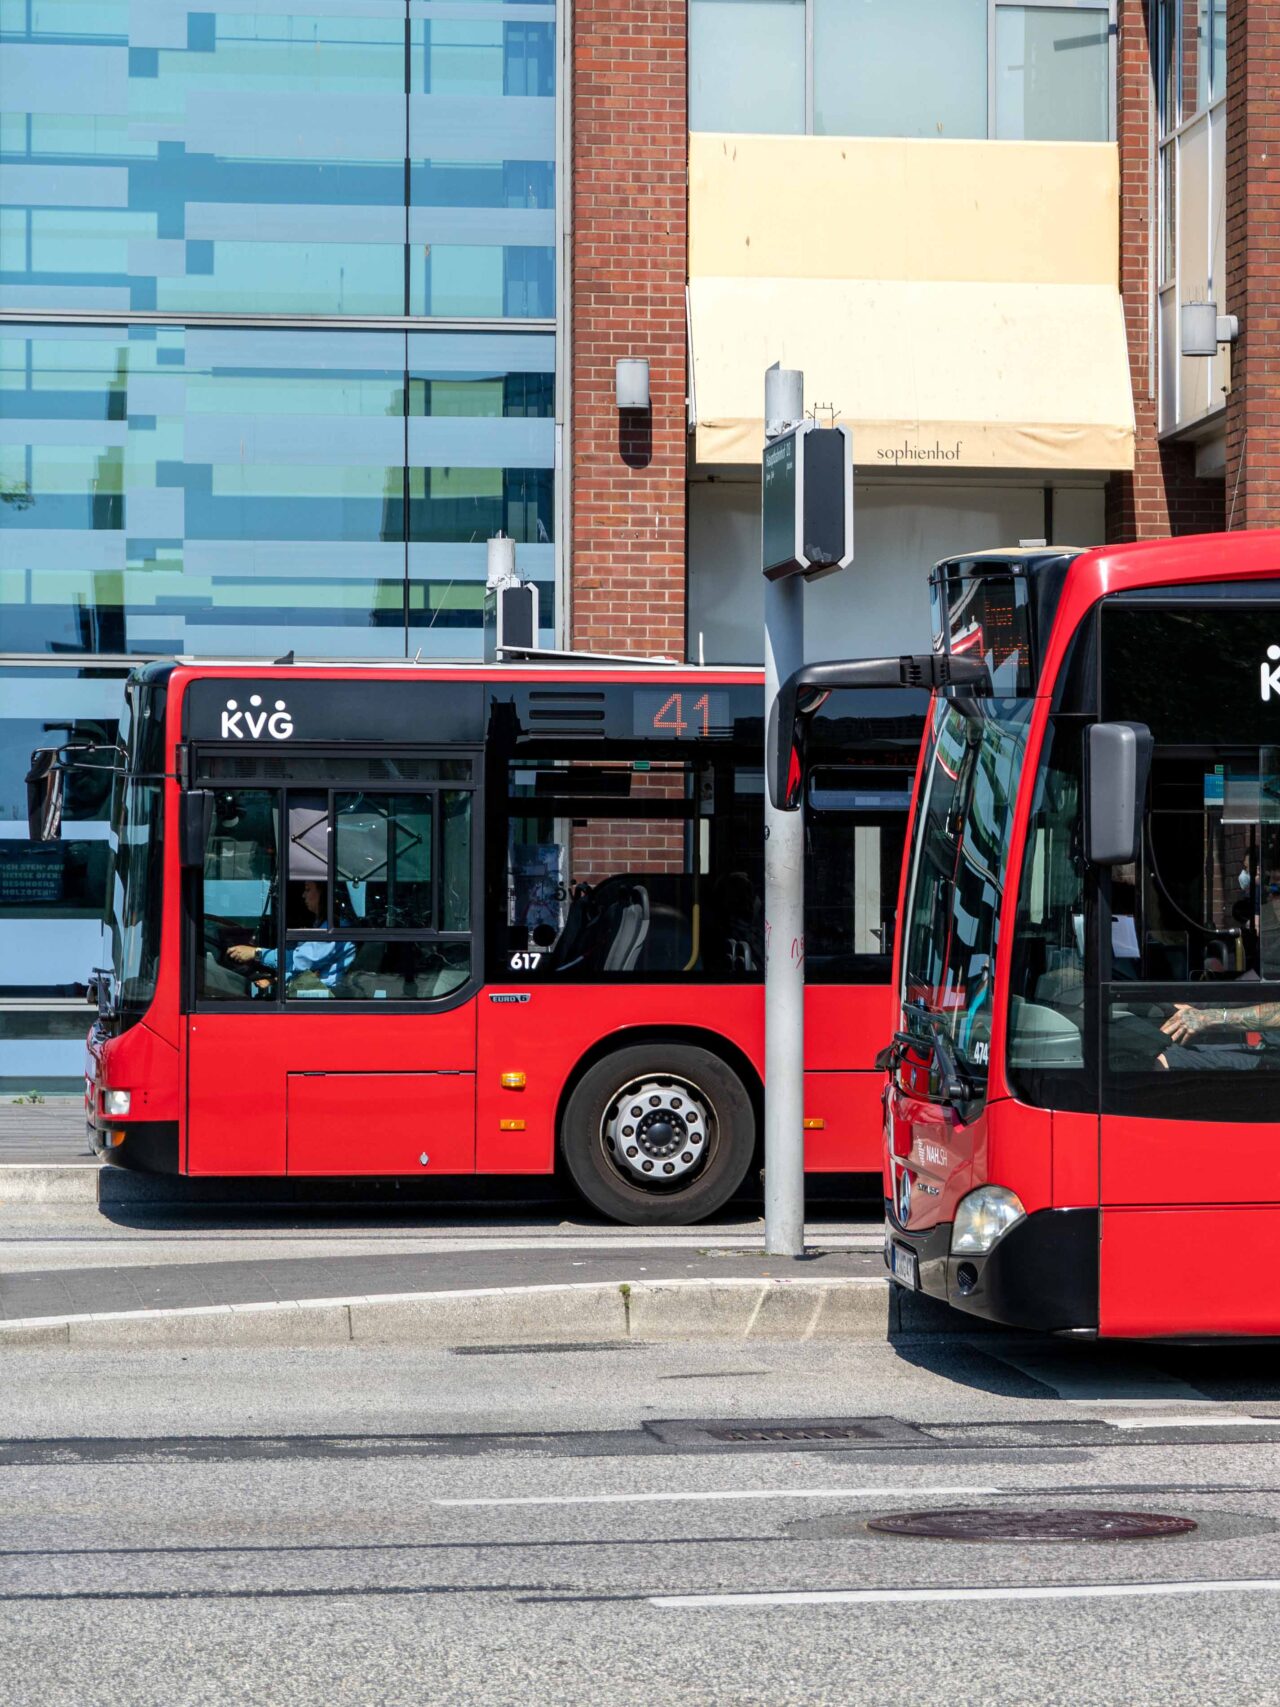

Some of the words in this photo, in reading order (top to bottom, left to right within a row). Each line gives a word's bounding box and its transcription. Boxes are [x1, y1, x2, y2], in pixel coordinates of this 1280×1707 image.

[876, 440, 963, 466] sophienhof
[221, 711, 294, 740] KVG
[652, 693, 709, 737] 41
[510, 952, 541, 970] 617
[974, 1041, 989, 1066] 474
